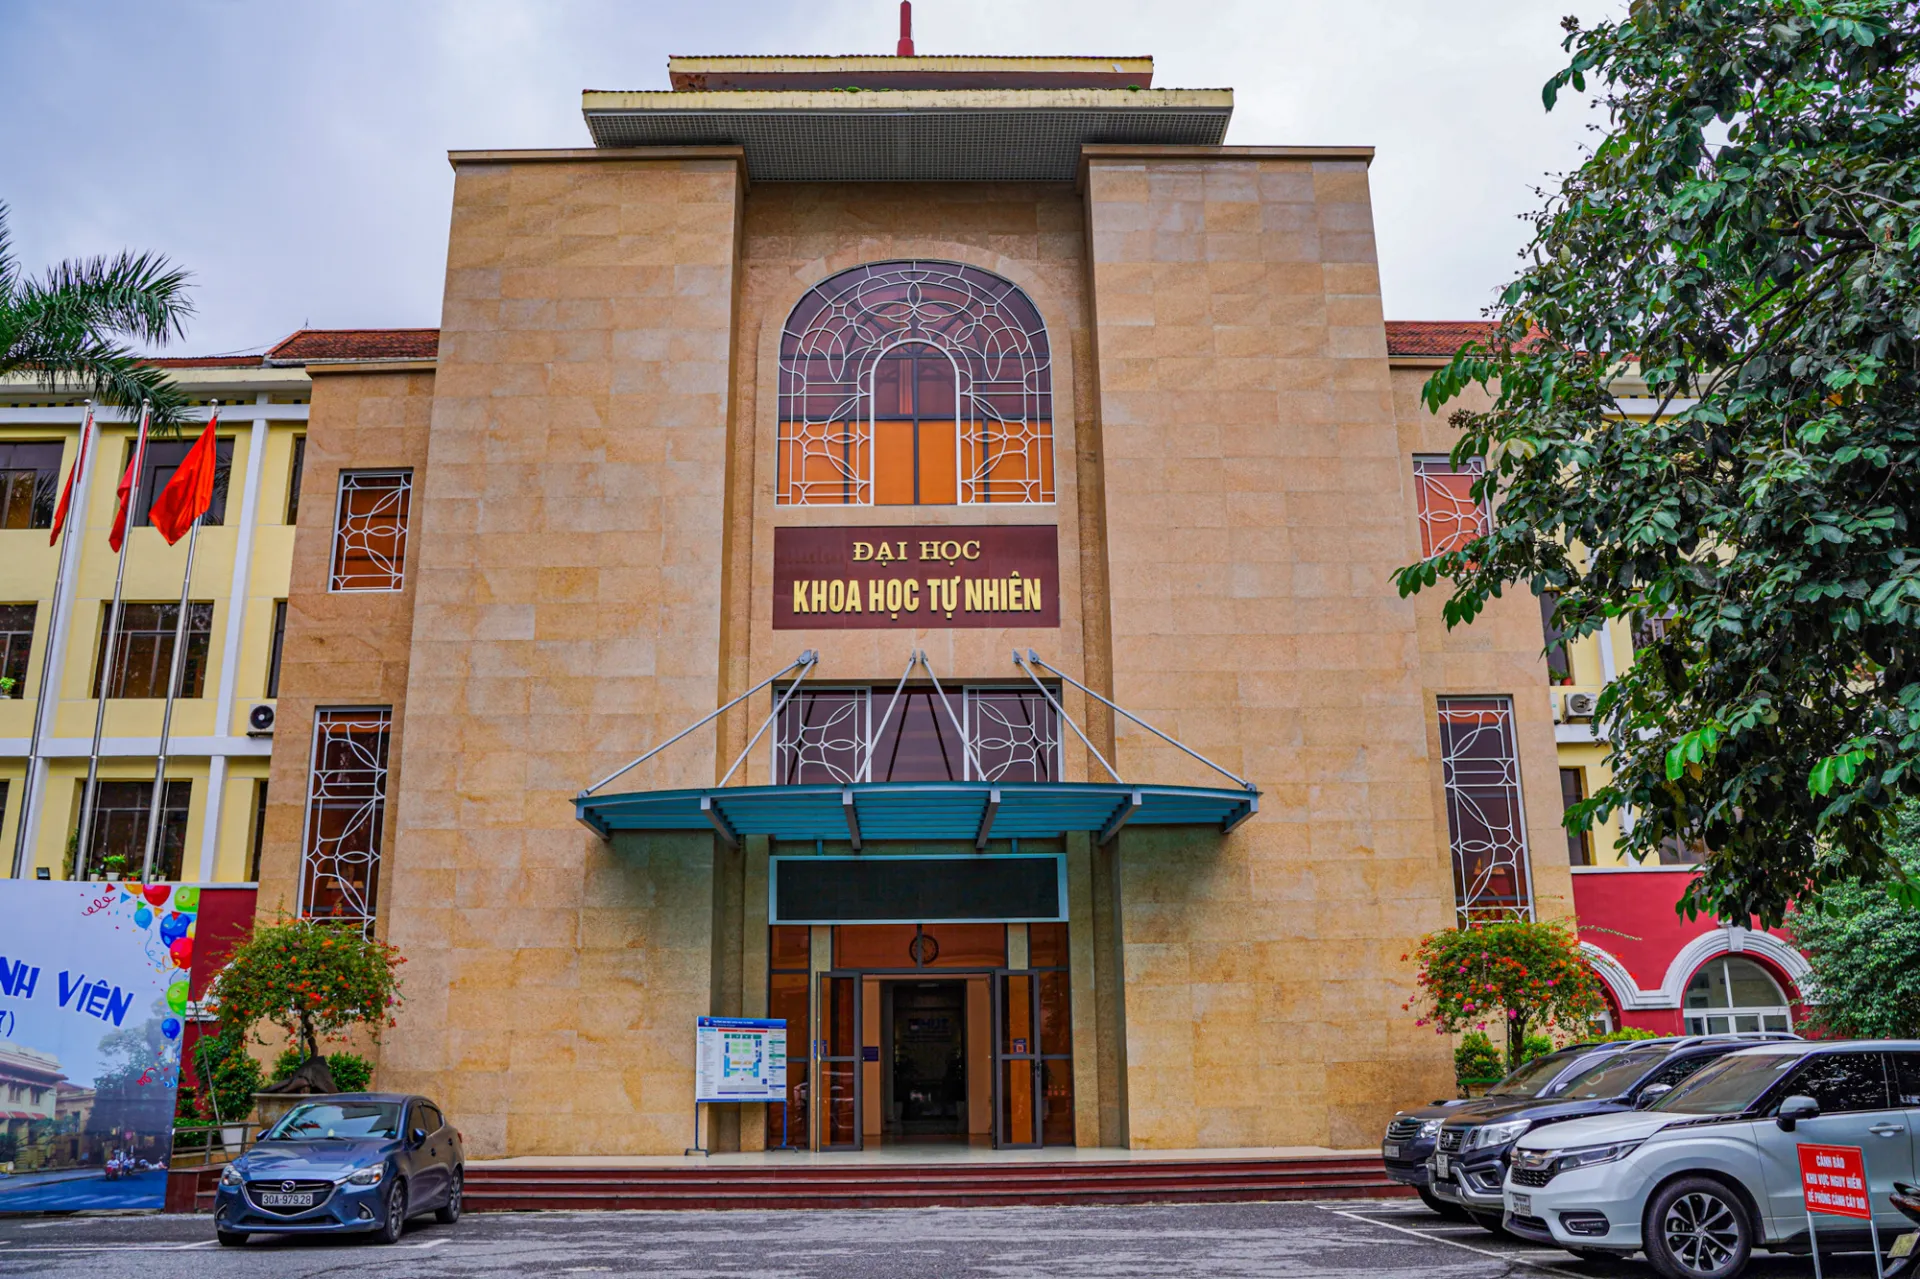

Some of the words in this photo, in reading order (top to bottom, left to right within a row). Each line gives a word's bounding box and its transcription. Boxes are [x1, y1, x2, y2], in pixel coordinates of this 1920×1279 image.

[853, 541, 907, 566] ĐẠI
[919, 540, 981, 566] HỌC
[793, 579, 862, 613] KHOA
[868, 578, 920, 620] HỌC
[927, 575, 961, 620] TỰ
[965, 570, 1042, 612] NHIÊN
[58, 970, 135, 1027] VIÊN
